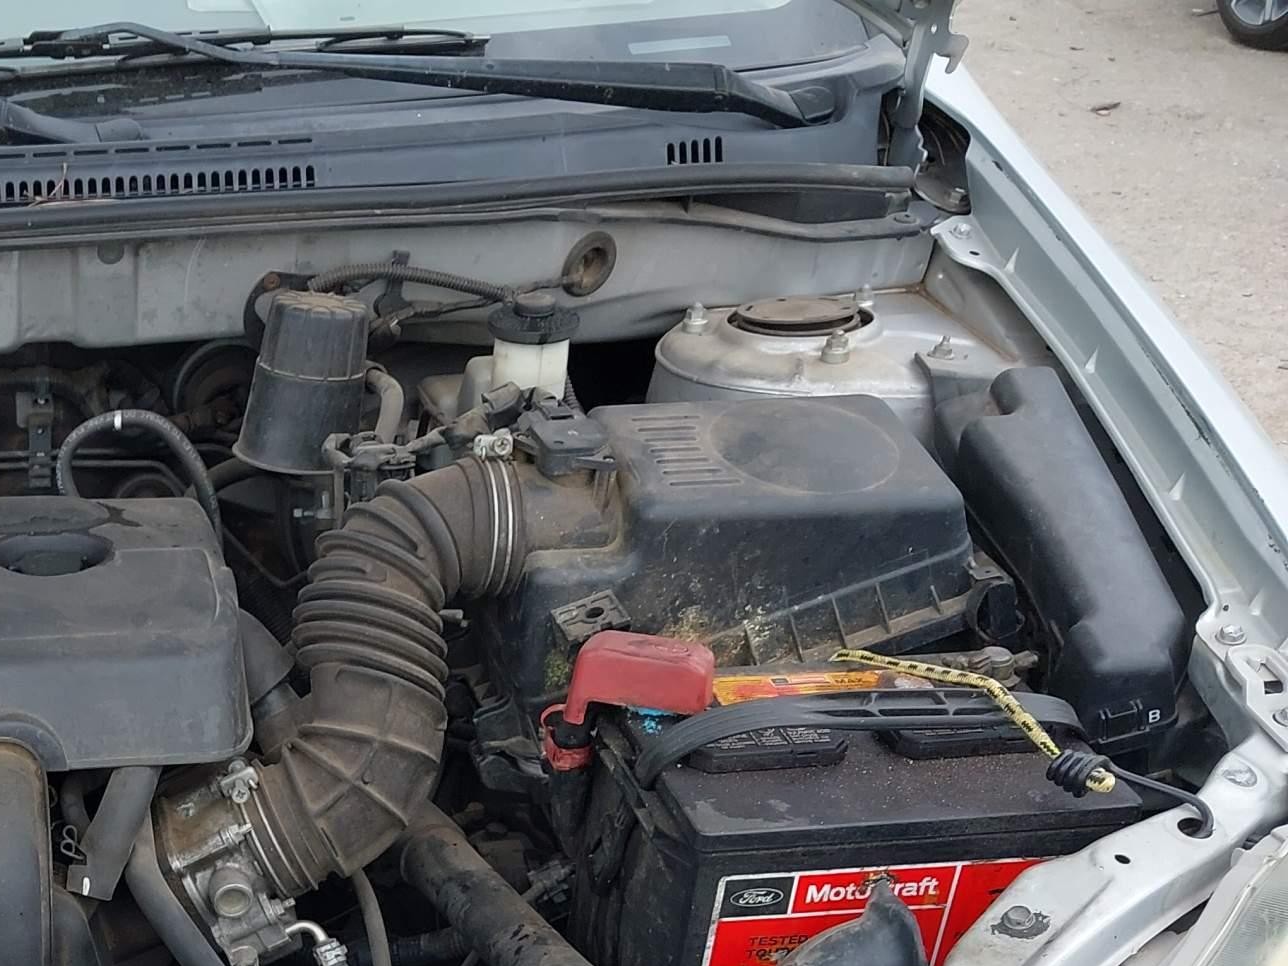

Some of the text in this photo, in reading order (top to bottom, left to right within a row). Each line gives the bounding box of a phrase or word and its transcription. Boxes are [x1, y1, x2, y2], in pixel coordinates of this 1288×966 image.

[1148, 709, 1161, 723] B
[805, 876, 940, 903] Motoraft
[749, 934, 809, 948] TESTED
